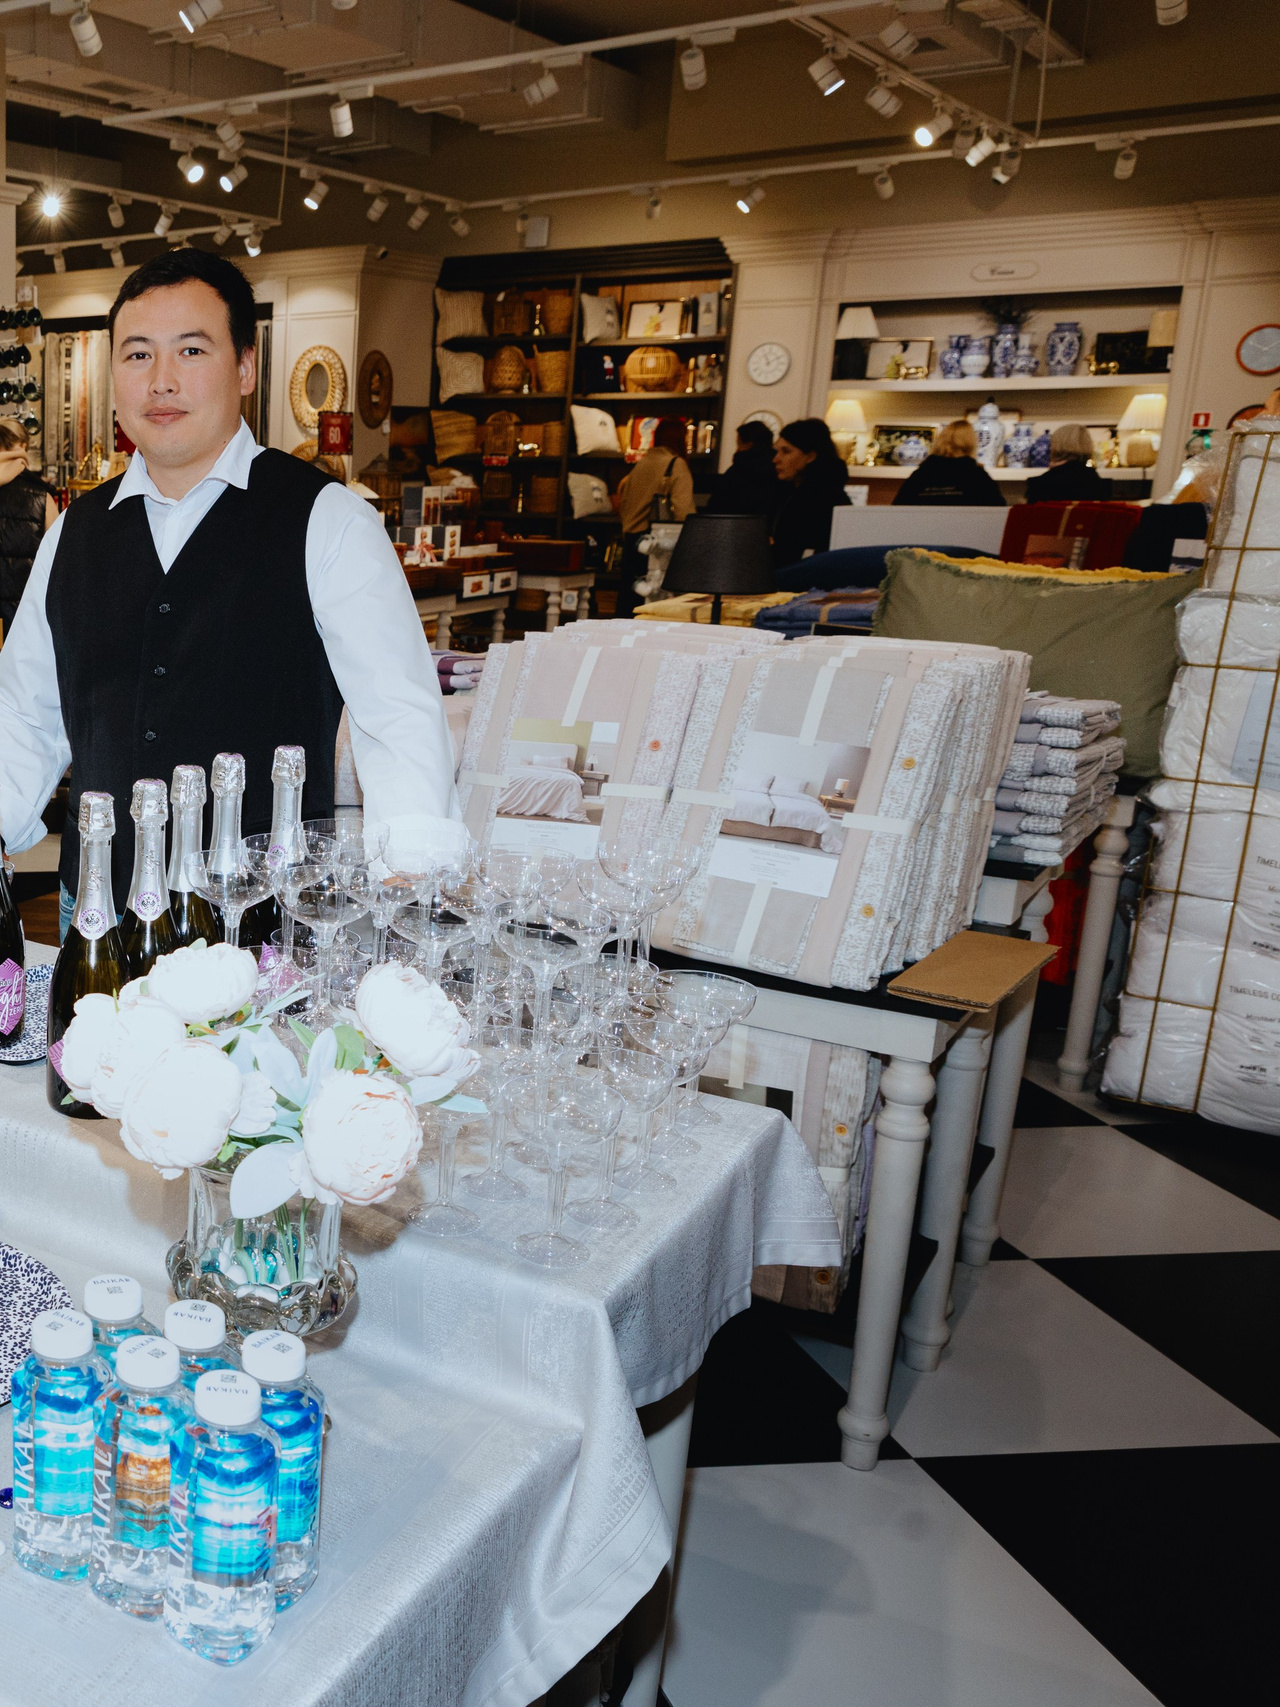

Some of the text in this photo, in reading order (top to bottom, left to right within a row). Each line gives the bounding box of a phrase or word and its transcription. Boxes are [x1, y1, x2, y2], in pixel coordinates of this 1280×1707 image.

[1229, 985, 1269, 999] TIMELESS
[14, 1424, 35, 1538] BAIKAL
[92, 1451, 112, 1562] BAIKAL
[167, 1487, 188, 1613] BIKAL
